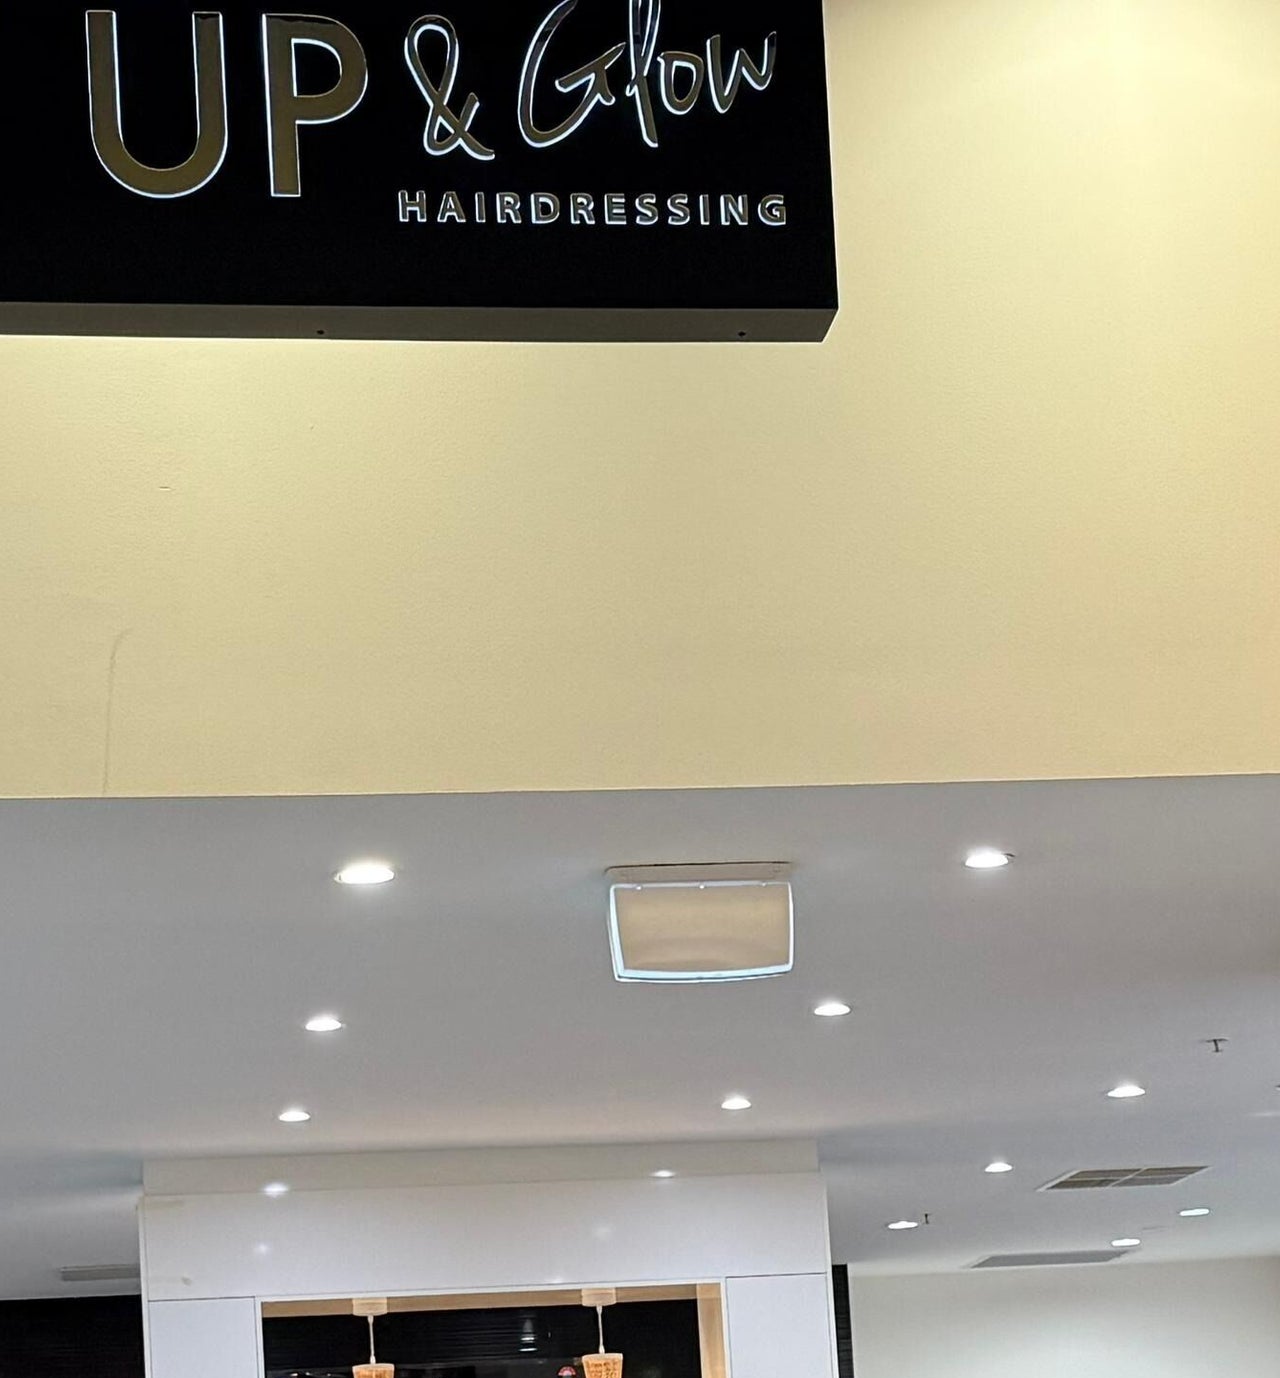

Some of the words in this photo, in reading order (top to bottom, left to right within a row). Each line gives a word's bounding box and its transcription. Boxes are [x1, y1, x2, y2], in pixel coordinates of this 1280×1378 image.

[85, 9, 369, 199] UP
[404, 14, 495, 160] &
[517, 0, 777, 148] Glow
[397, 189, 787, 226] HAIRDRESSING
